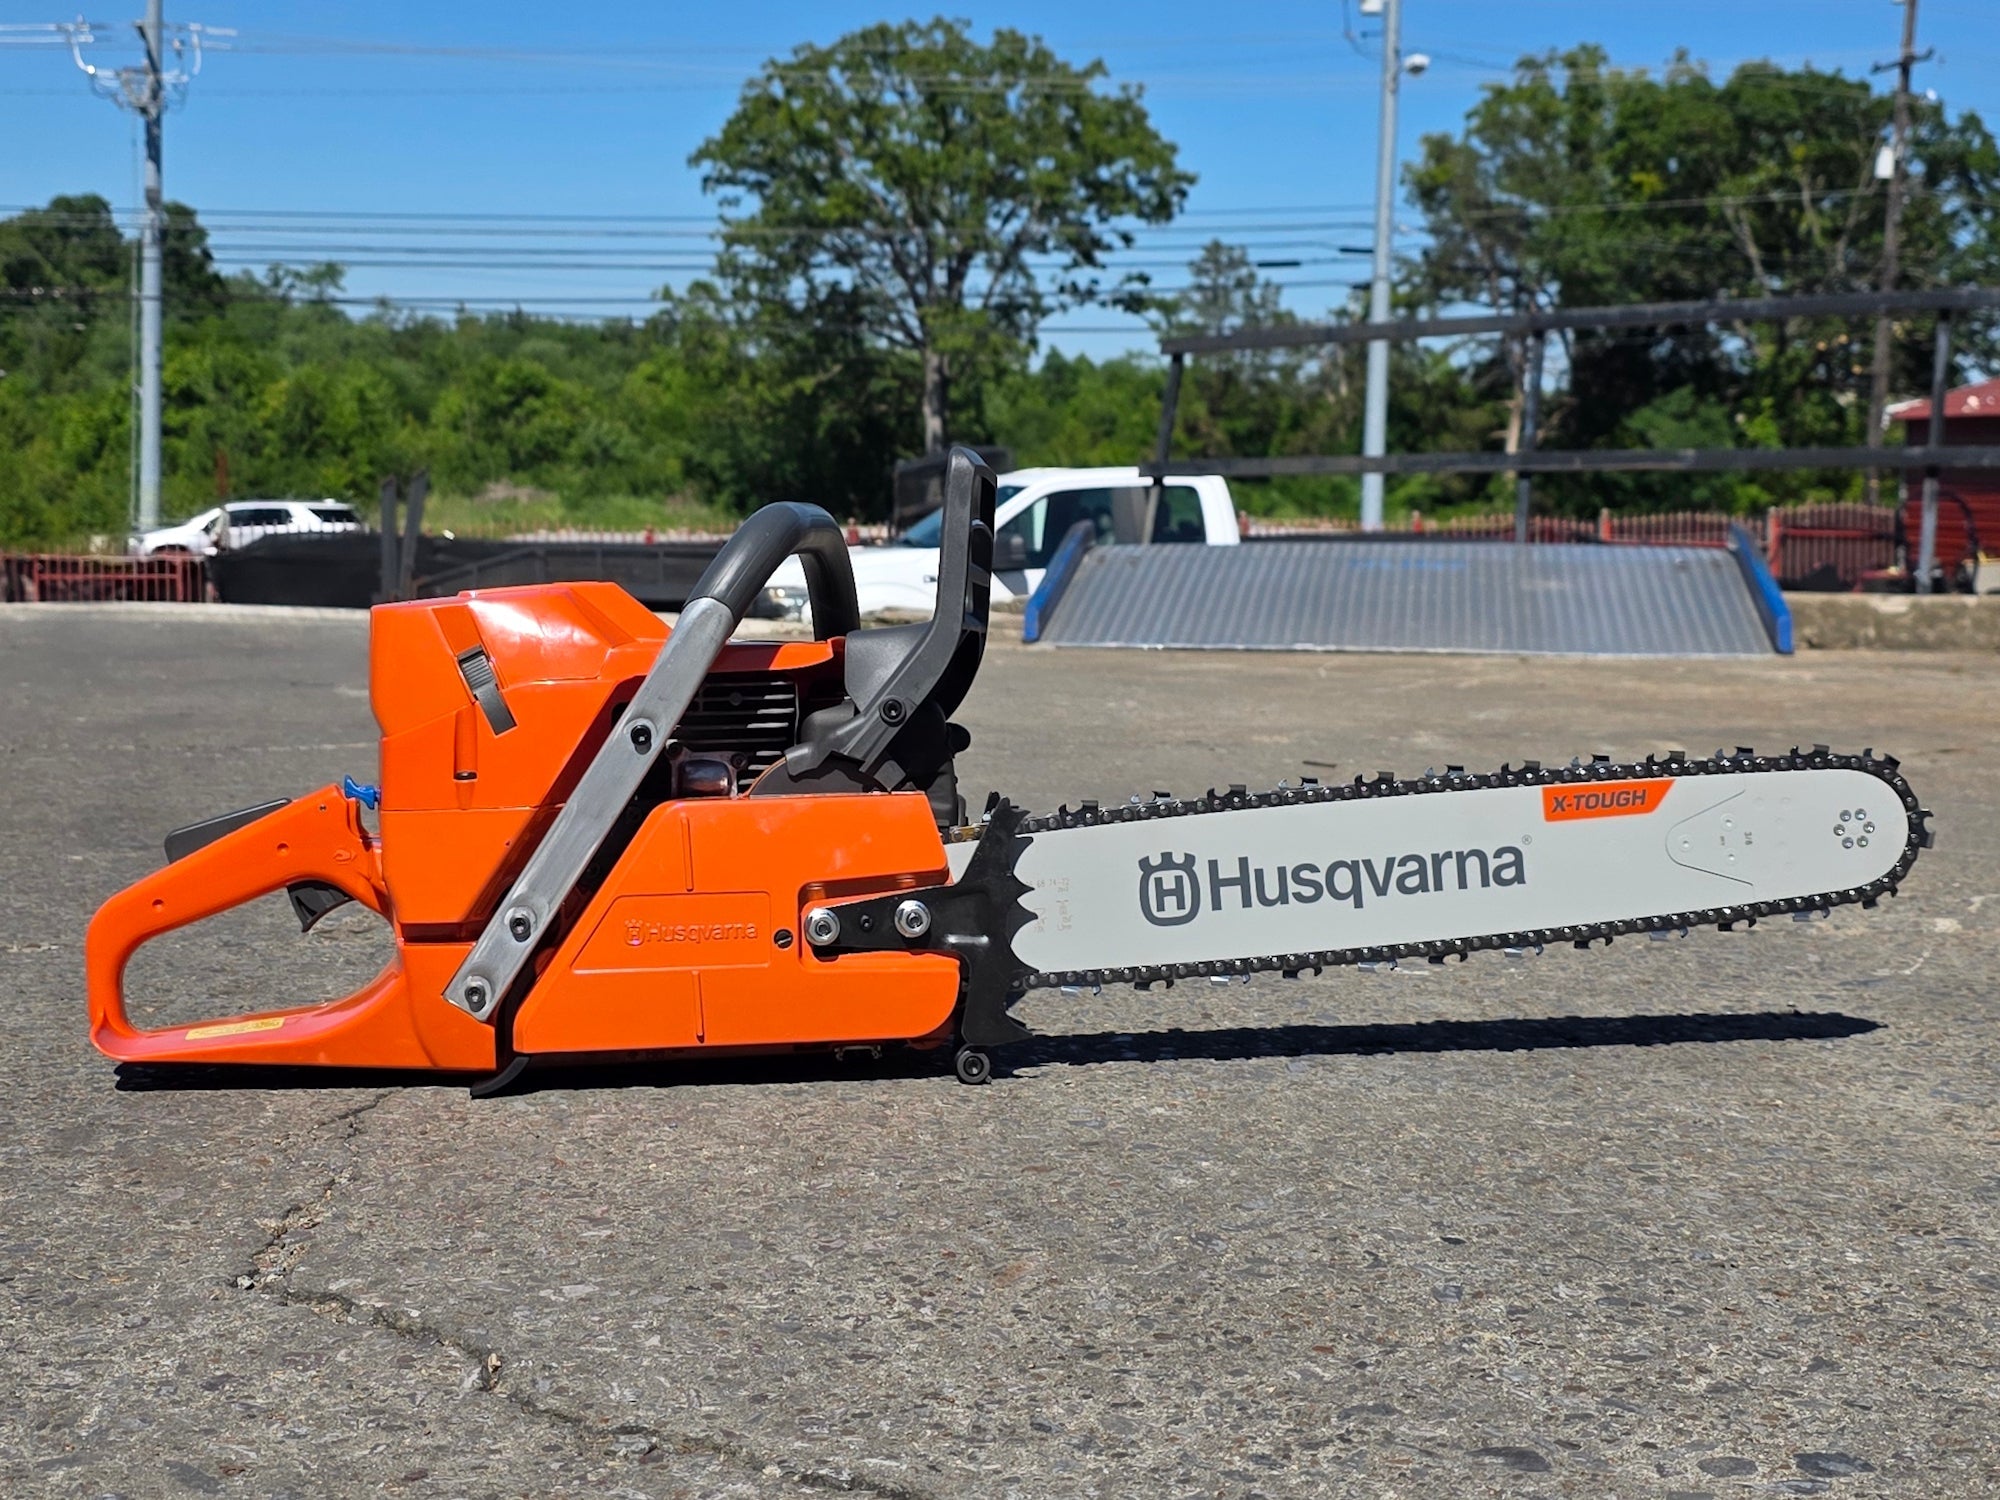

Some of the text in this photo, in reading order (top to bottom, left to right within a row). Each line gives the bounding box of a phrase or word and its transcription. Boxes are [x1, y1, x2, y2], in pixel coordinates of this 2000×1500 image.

[1552, 789, 1646, 813] X-TOUGH
[1208, 845, 1526, 911] Husqvarna
[645, 922, 759, 944] Husqvarna
